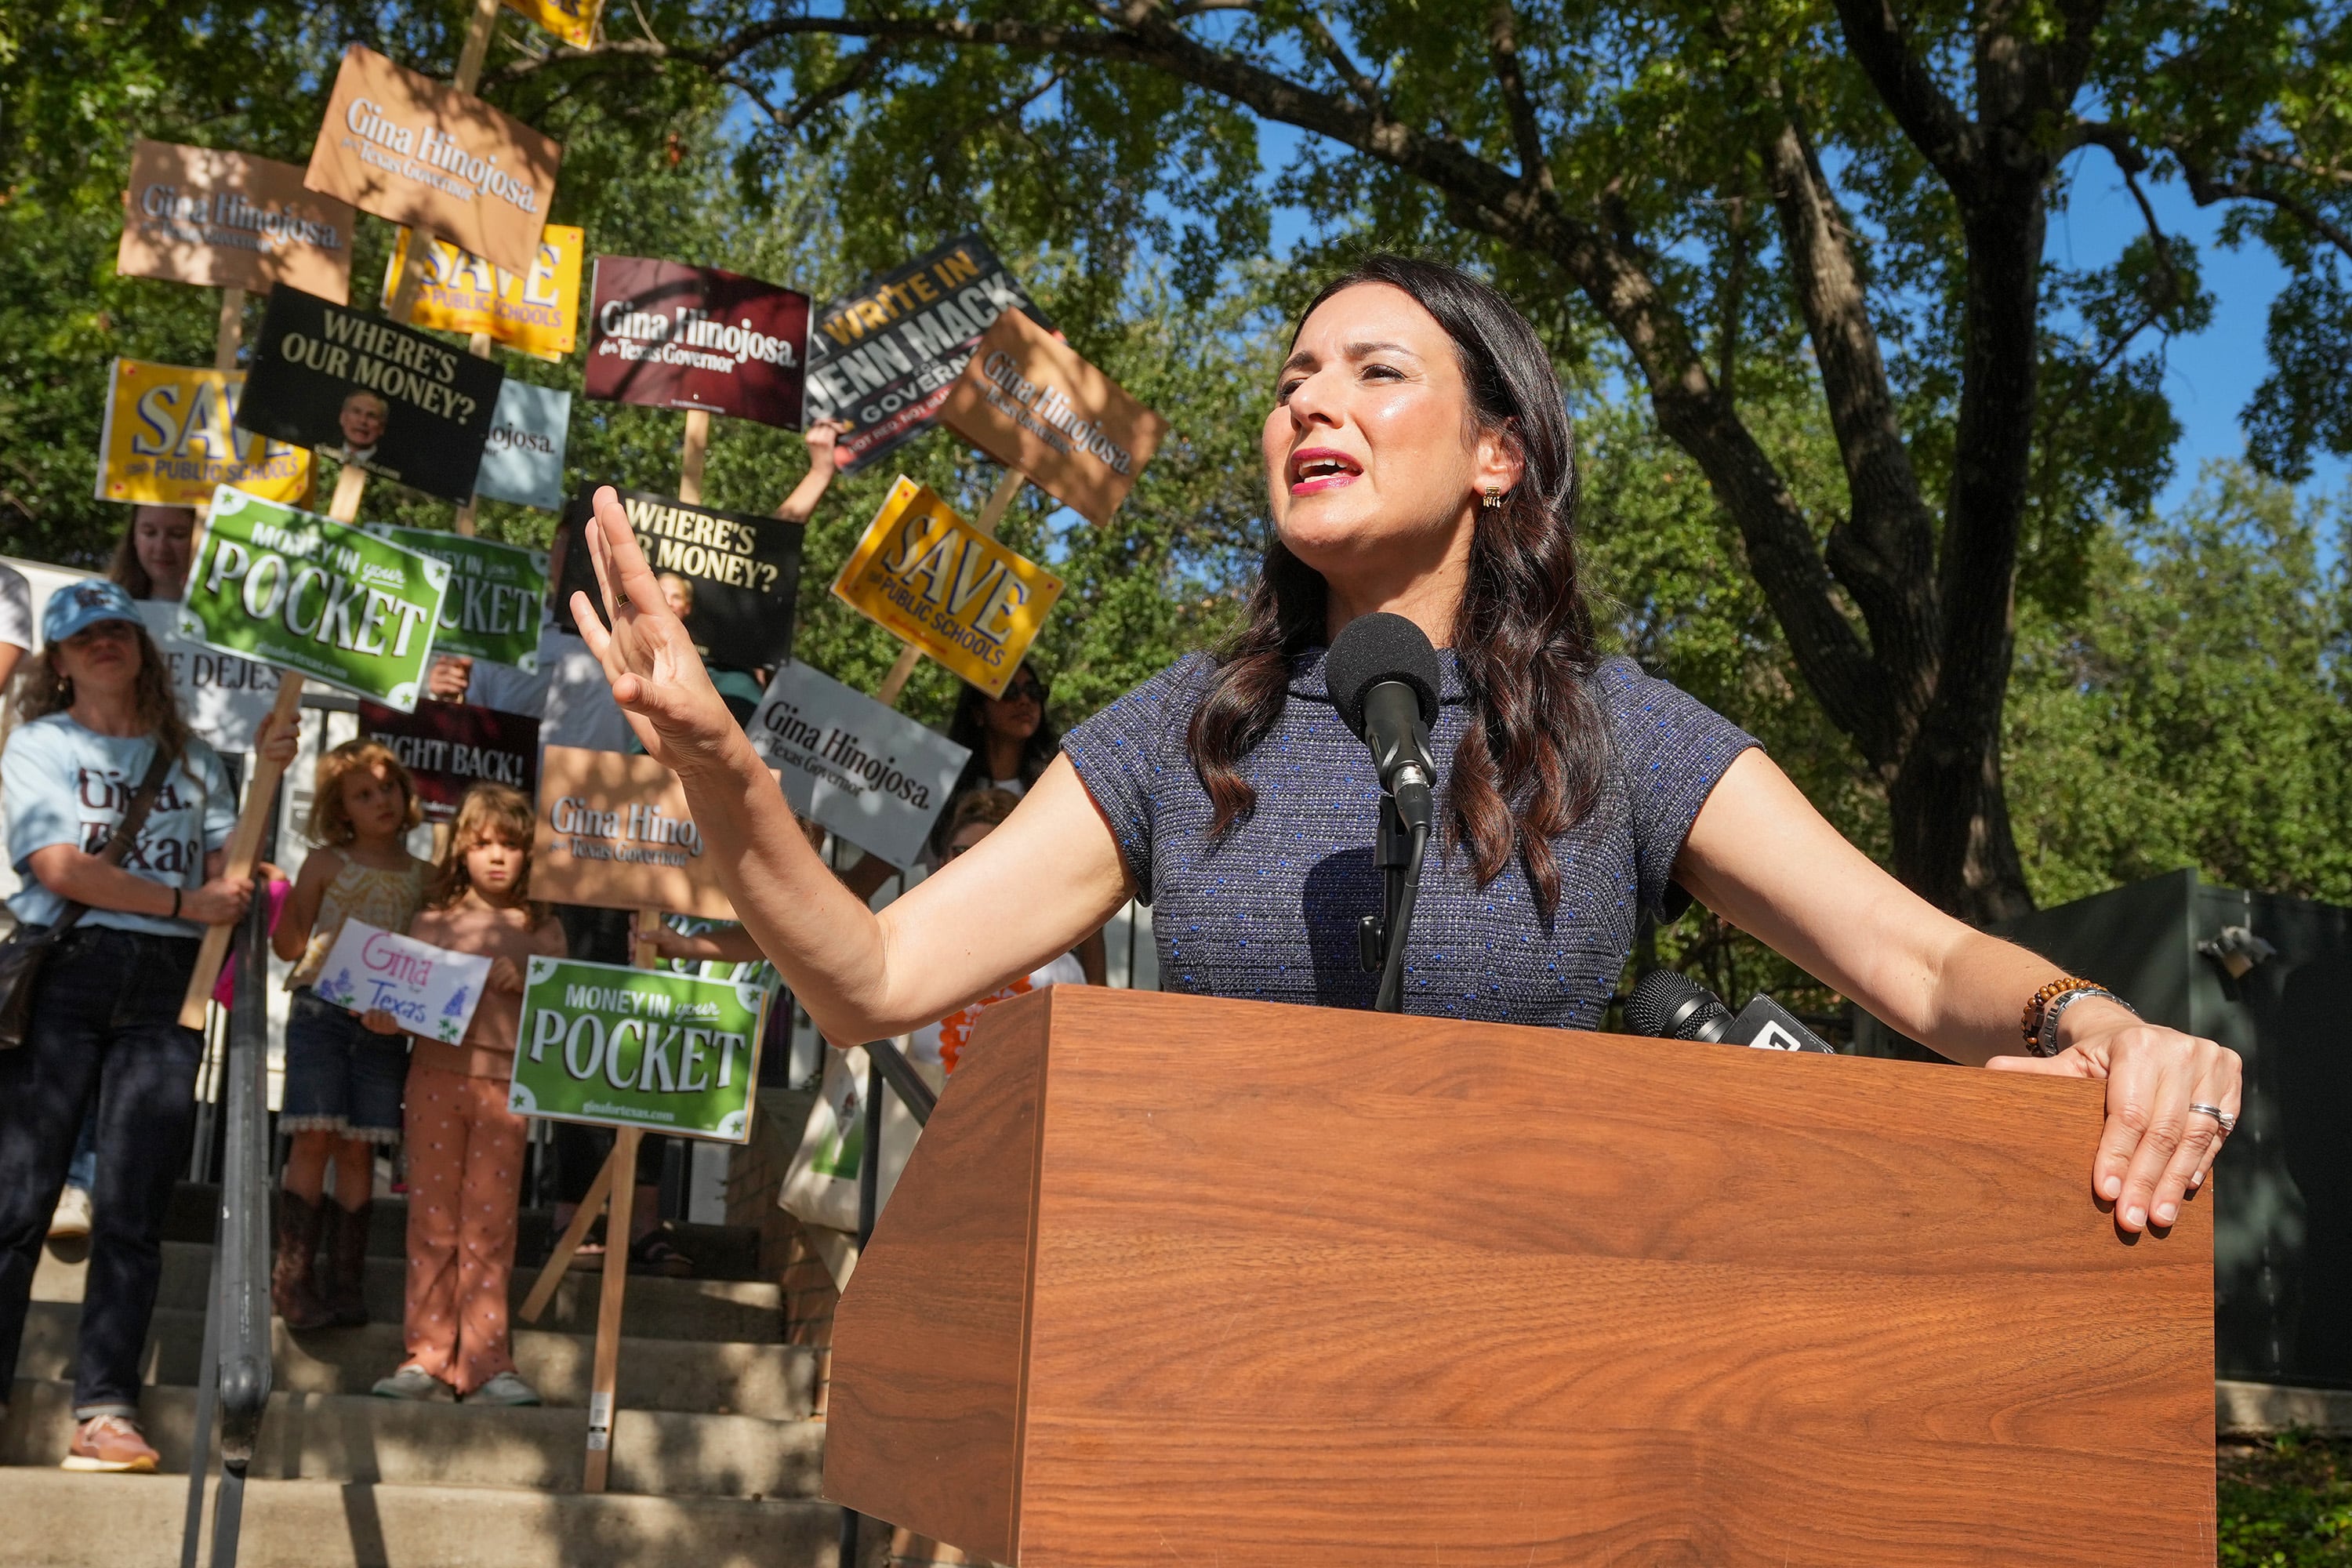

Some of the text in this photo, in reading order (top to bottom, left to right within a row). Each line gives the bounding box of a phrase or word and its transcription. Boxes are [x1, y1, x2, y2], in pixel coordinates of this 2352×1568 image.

[347, 97, 539, 214] Gina Hinojosa.
[359, 140, 401, 174] Texas
[402, 158, 474, 201] Governor
[142, 183, 209, 225] Gina
[215, 191, 343, 249] Hinojosa.
[431, 289, 492, 312] PUBLIC
[494, 299, 563, 328] SCHOOLS
[823, 251, 980, 347] WRITE IN
[324, 309, 458, 383] WHERE'S
[599, 338, 736, 374] for Texas Governor
[601, 299, 797, 368] Gina Hinojosa.
[806, 271, 1028, 419] JENN MACK
[281, 332, 476, 426] OUR MONEY?
[985, 387, 1018, 419] Texas
[984, 350, 1131, 474] Gina Hinojosa.
[154, 459, 222, 483] PUBLIC
[225, 456, 298, 484] SCHOOLS
[250, 521, 406, 585] MONEY IN your
[625, 498, 757, 555] WHERE'S
[655, 539, 779, 593] MONEY?
[881, 514, 1031, 645] SAVE
[205, 539, 428, 658] POCKET
[879, 576, 932, 622] PUBLIC
[931, 612, 1005, 667] SCHOOLS
[191, 654, 283, 691] DEJES
[452, 747, 524, 786] BACK!
[764, 700, 930, 811] Gina Hinojosa.
[768, 738, 804, 768] Texas
[804, 757, 866, 798] Governor
[551, 796, 621, 838] Gina
[571, 837, 612, 860] Texas
[614, 841, 688, 867] Governor
[362, 931, 434, 987] Gina
[367, 978, 426, 1024] Texas
[564, 983, 720, 1022] MONEY IN your
[528, 1008, 746, 1094] POCKET
